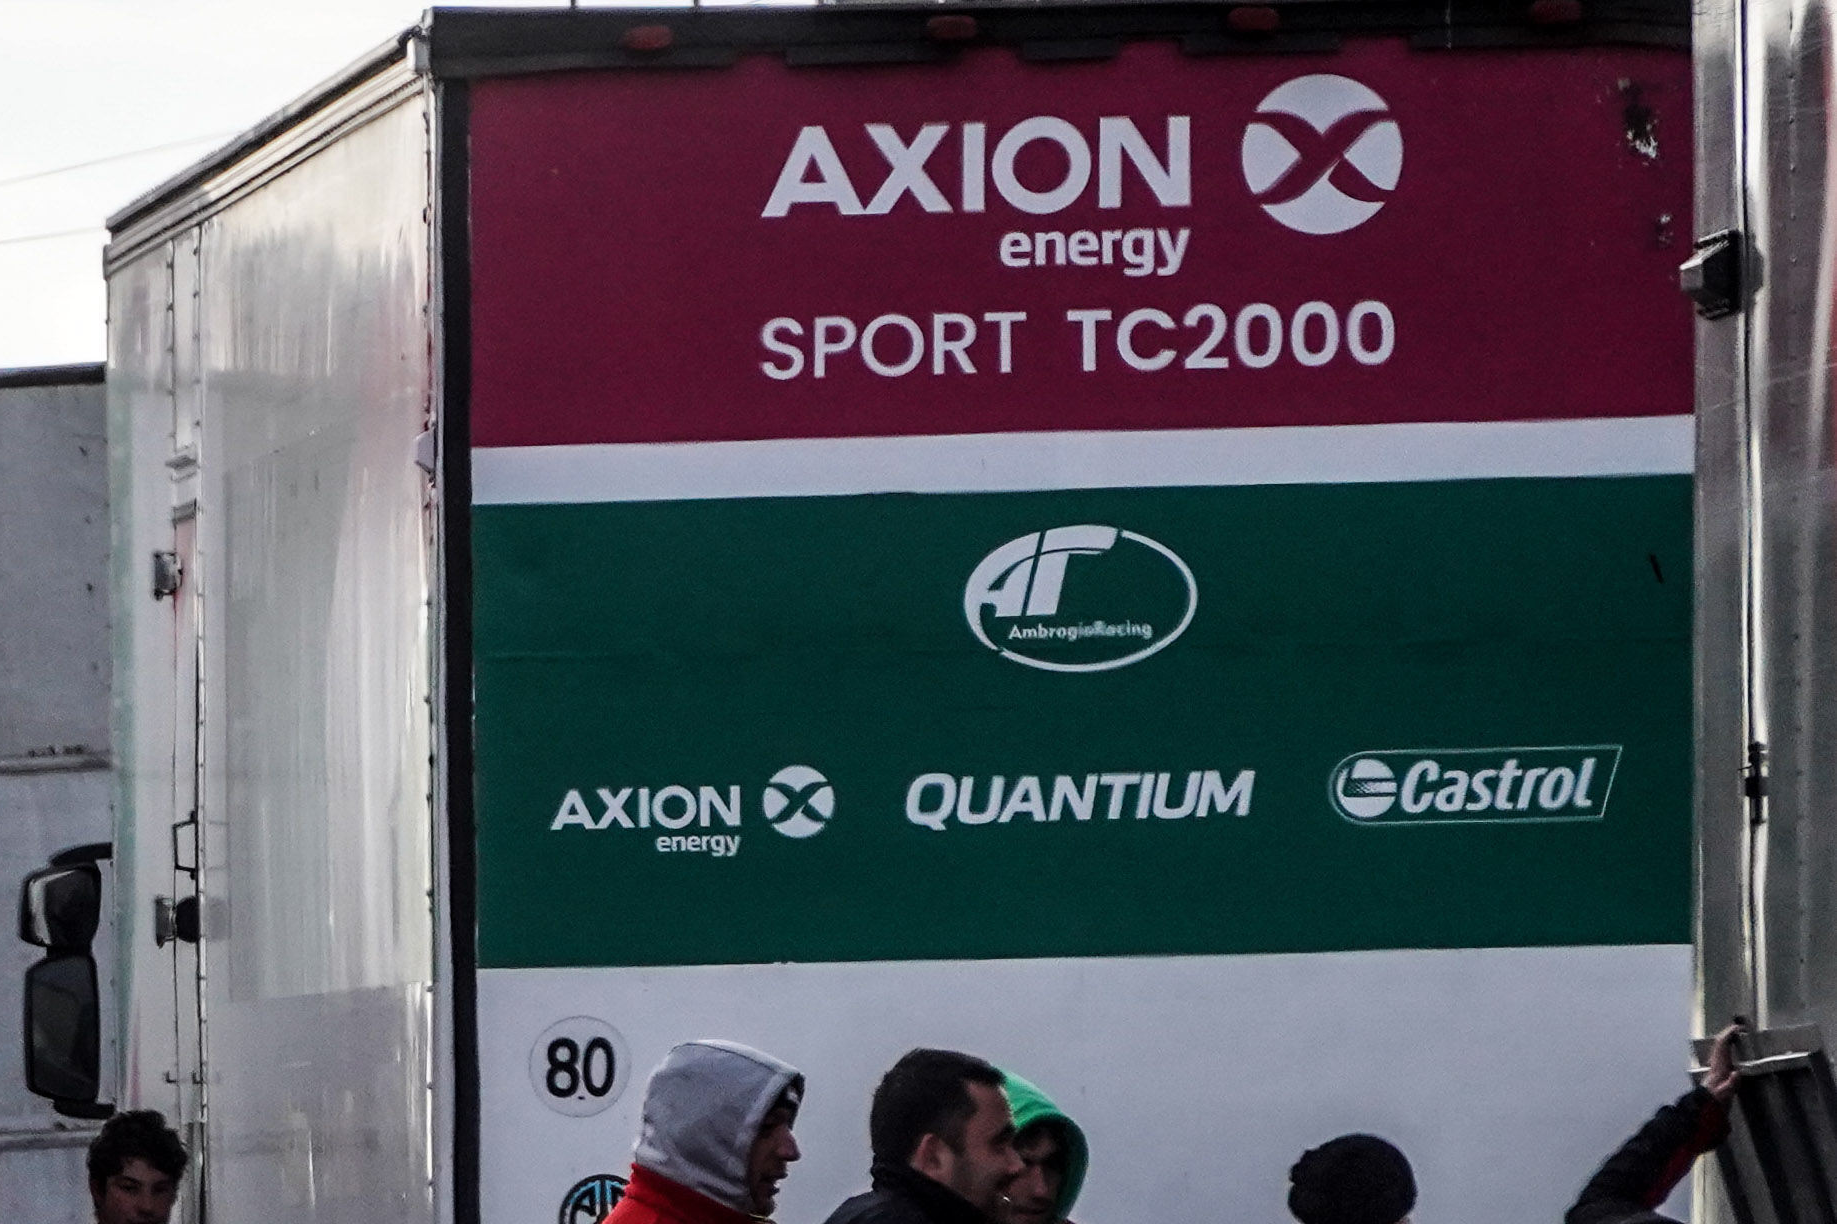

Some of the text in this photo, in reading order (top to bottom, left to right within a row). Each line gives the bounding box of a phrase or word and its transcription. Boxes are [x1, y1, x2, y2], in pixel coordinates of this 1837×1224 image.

[761, 115, 1192, 218] AXION
[999, 227, 1191, 277] energy
[760, 299, 1396, 381] SPORT TC2000
[550, 785, 741, 832] AXION
[906, 770, 1255, 831] QUANTIUM
[1399, 756, 1595, 815] Castrol
[655, 830, 741, 857] energy
[546, 1036, 616, 1098] 80
